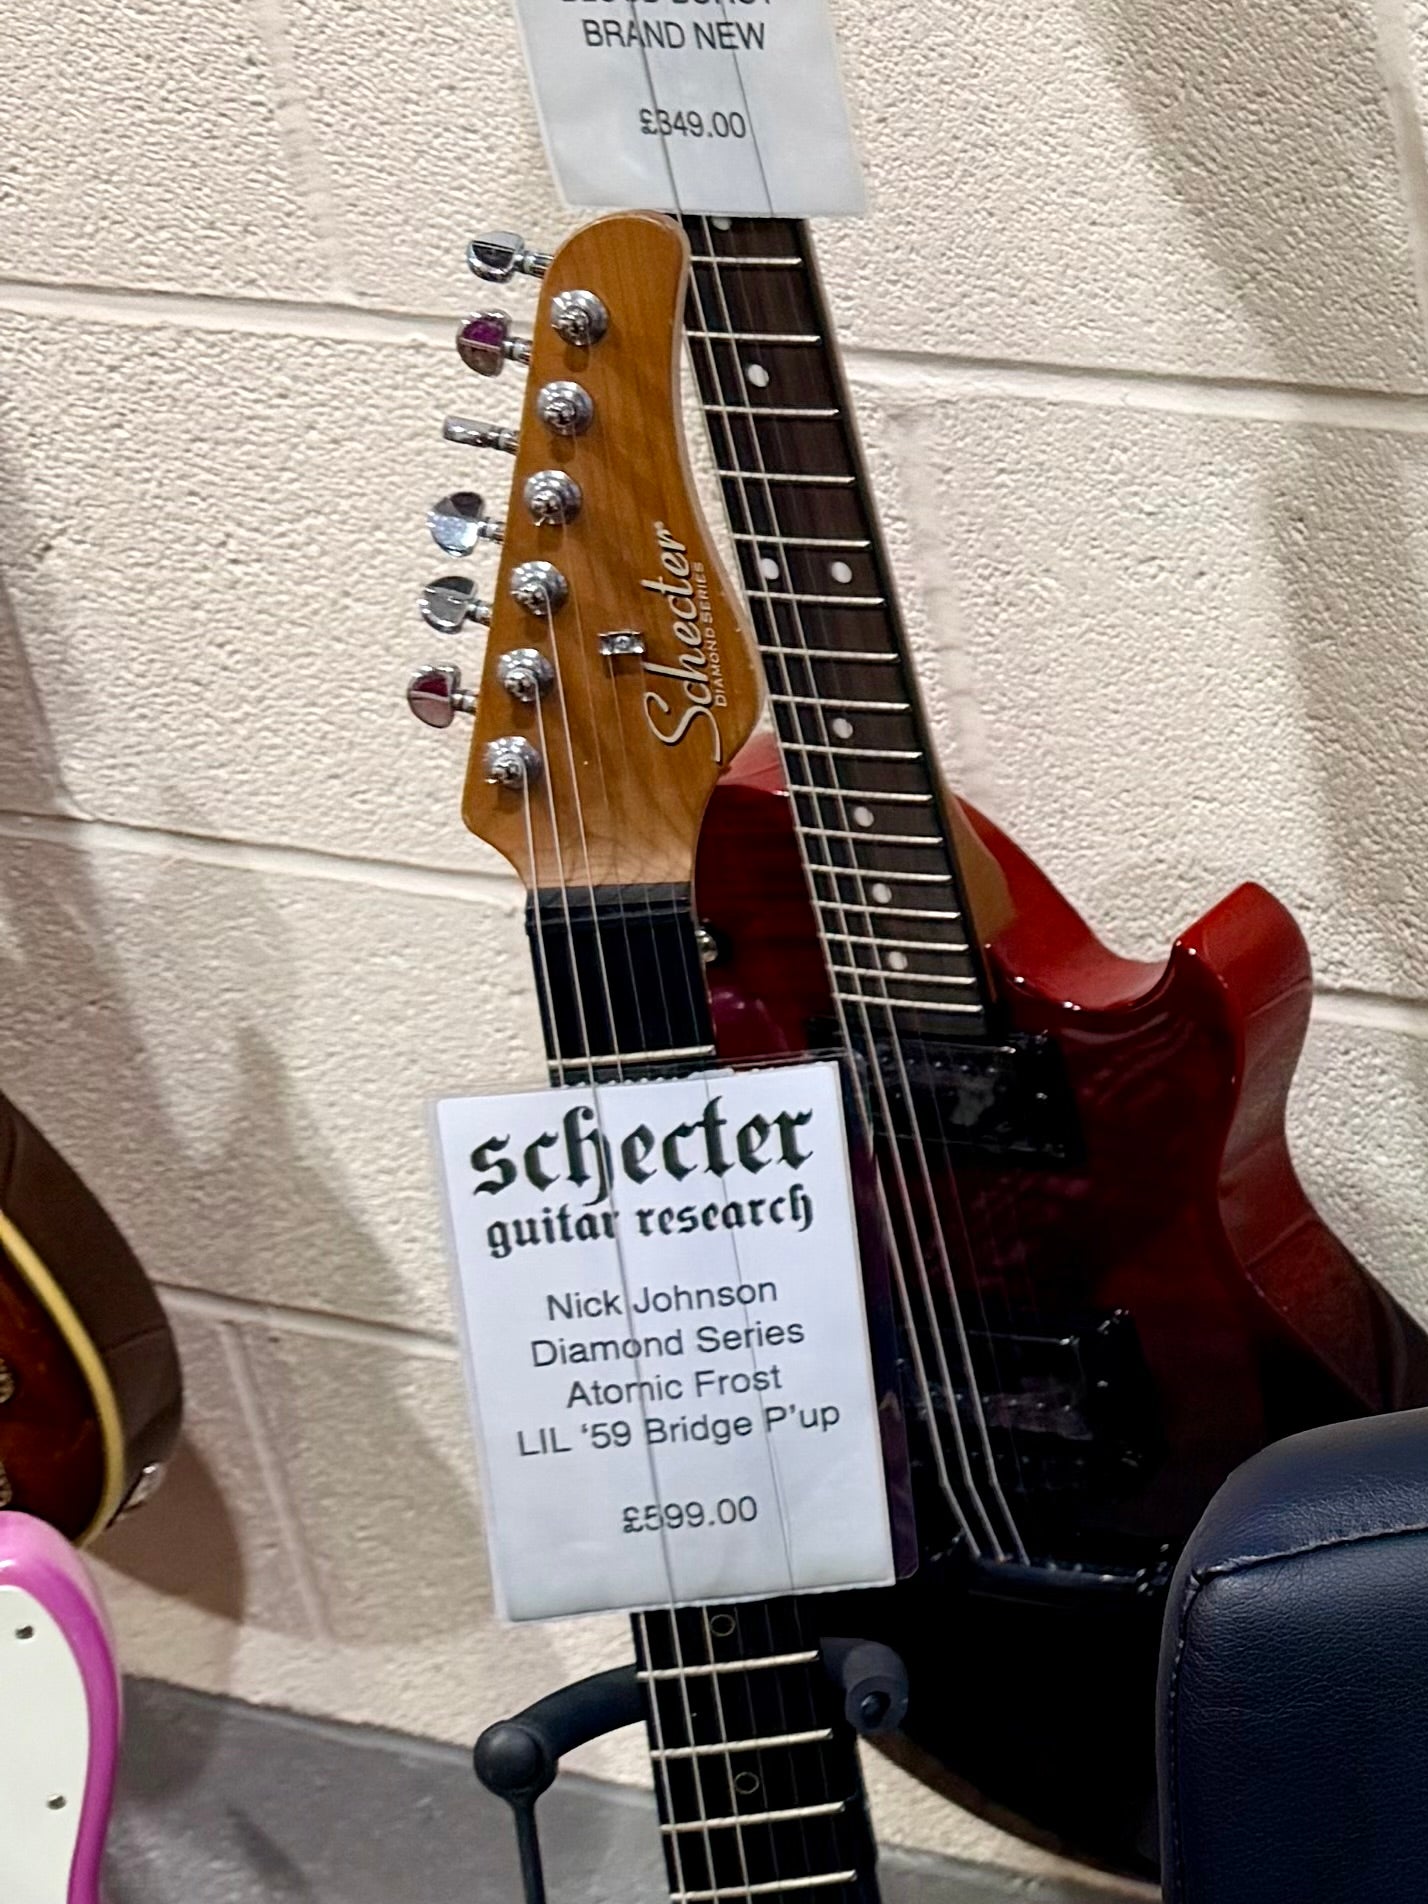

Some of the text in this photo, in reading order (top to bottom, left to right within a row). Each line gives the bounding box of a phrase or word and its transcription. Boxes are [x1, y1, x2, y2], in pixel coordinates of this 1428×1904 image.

[581, 19, 766, 50] BRAND NEW
[640, 528, 721, 764] Schecter
[469, 1096, 813, 1205] schecter
[487, 1184, 814, 1259] guitar research
[546, 1279, 779, 1322] Nick Johnson
[530, 1319, 805, 1368] Diamond Series
[566, 1363, 783, 1409] Atomic Frost
[516, 1427, 572, 1457] LIL
[646, 1413, 754, 1448] Bridge
[621, 1495, 760, 1533] £599.00
